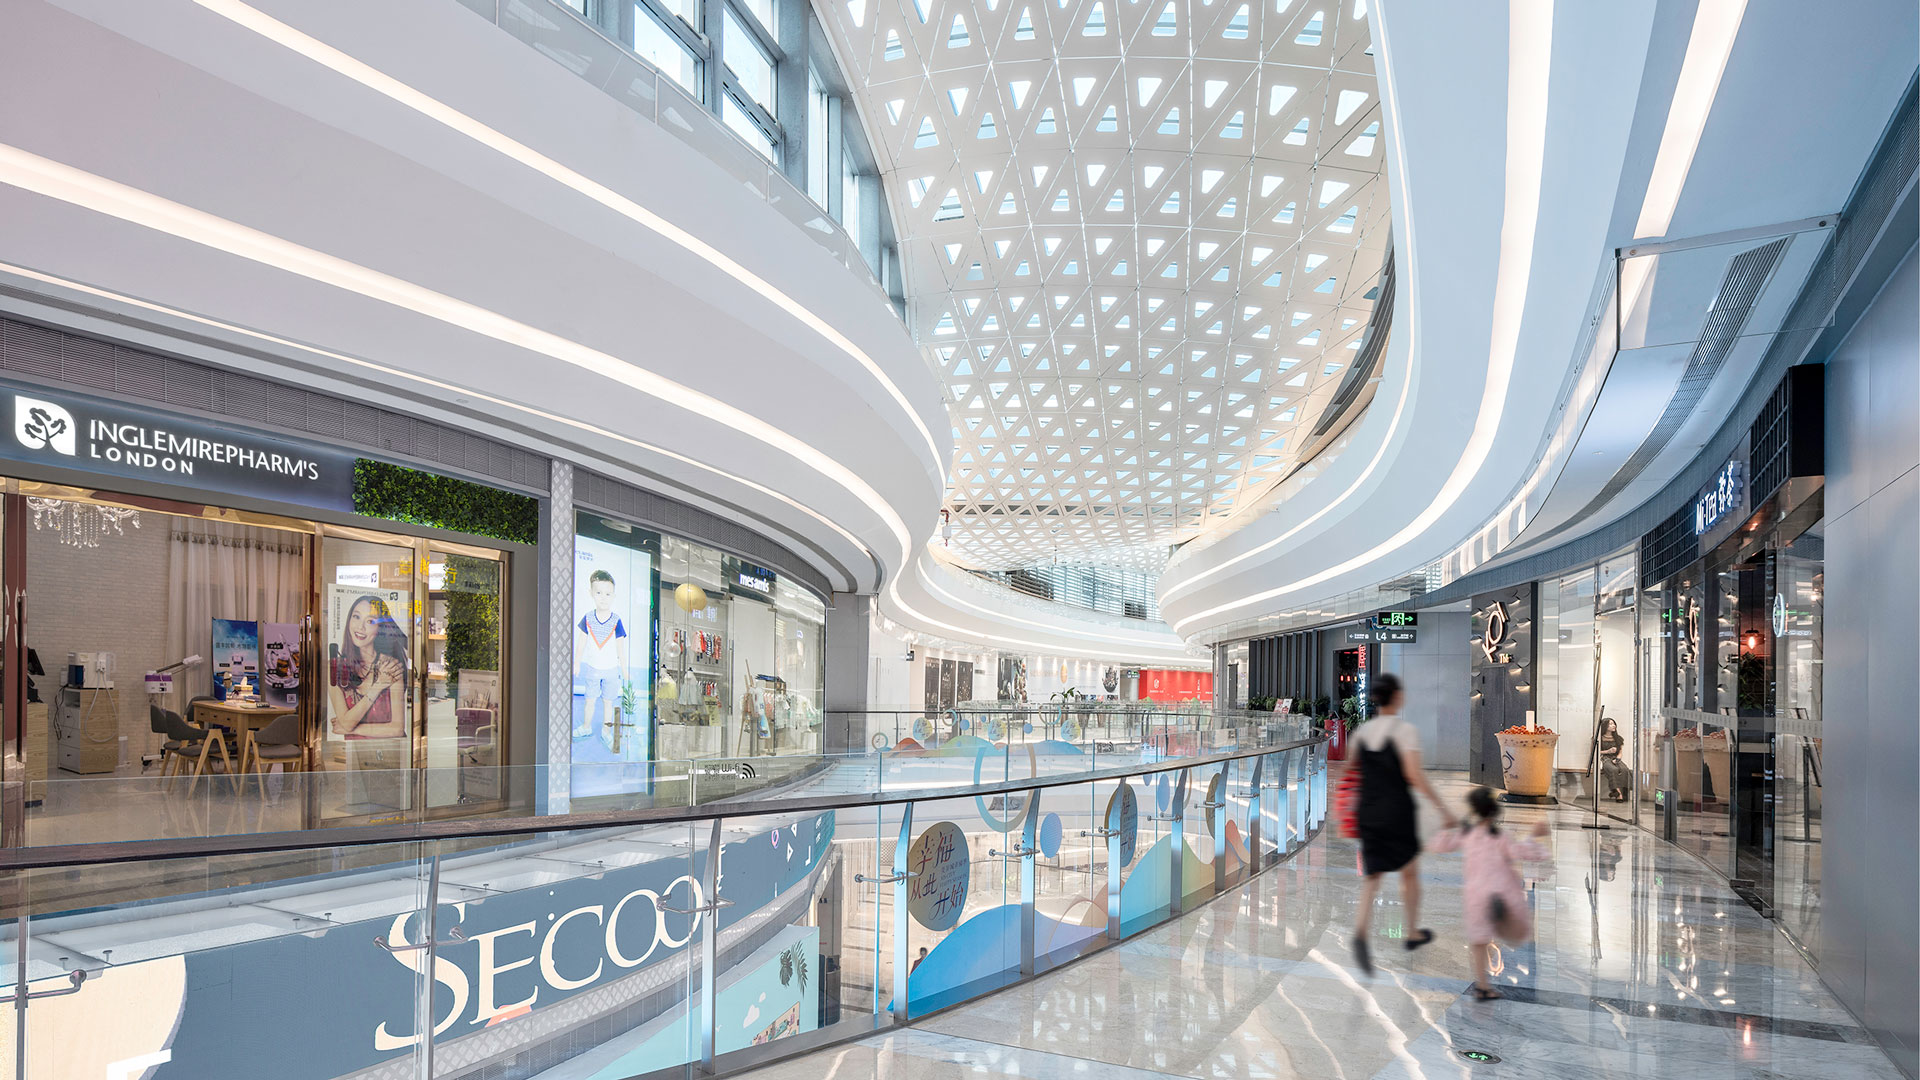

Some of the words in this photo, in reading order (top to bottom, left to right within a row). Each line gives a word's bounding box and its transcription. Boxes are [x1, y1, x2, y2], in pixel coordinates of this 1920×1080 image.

[90, 419, 319, 481] INGLEMIREPHARM'S
[90, 443, 193, 476] LONDON
[1375, 632, 1387, 641] L4
[1482, 601, 1505, 664] KOI
[930, 881, 964, 920] 开始
[374, 874, 703, 1051] SECOO
